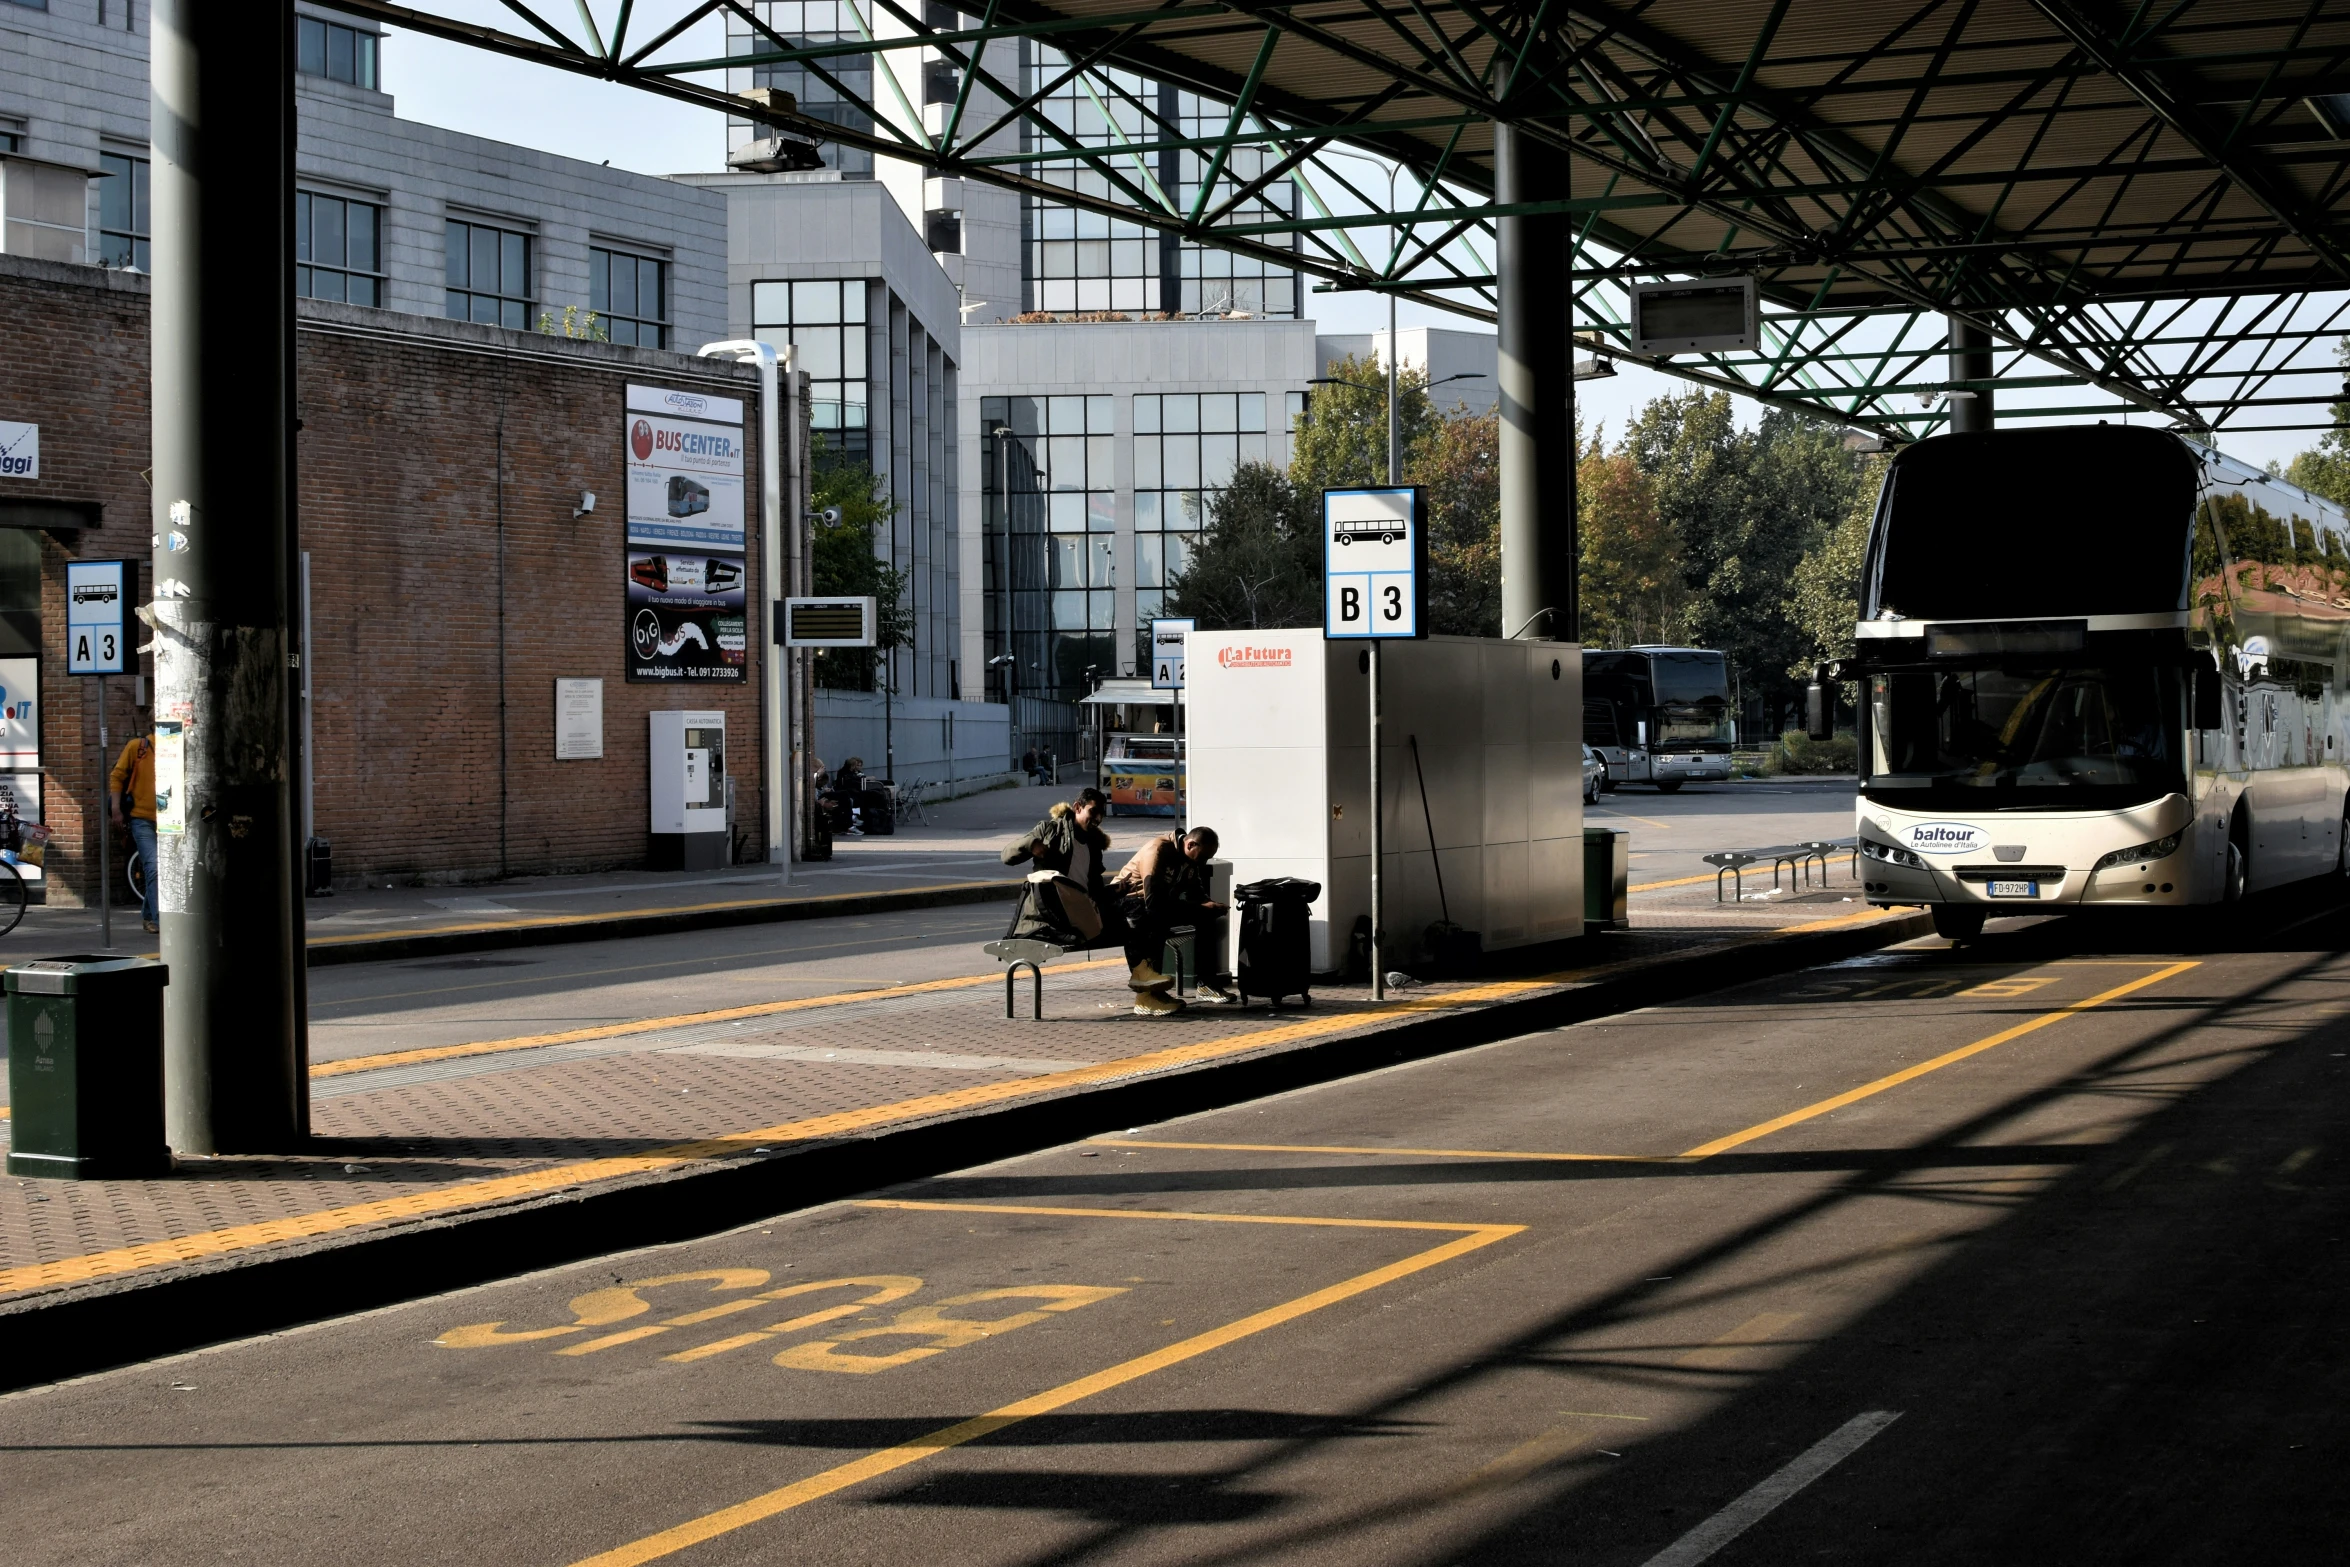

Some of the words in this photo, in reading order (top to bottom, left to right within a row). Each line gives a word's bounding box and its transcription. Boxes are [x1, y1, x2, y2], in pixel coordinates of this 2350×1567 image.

[656, 430, 740, 458] BUSCENTER.IT
[0, 456, 32, 474] ggi
[693, 598, 712, 607] viaggiare
[1341, 587, 1360, 621] B
[1384, 586, 1402, 620] 3
[76, 636, 90, 661] A
[104, 634, 115, 660] 3
[1245, 646, 1292, 660] Futura
[637, 666, 683, 678] www.bigbus.it
[687, 667, 698, 676] Tel.
[699, 668, 711, 676] 091
[712, 668, 739, 677] 2733926
[1159, 664, 1170, 681] A
[1914, 827, 1975, 841] baltour
[1779, 976, 2064, 998] BUS
[434, 1268, 1131, 1374] BUS
